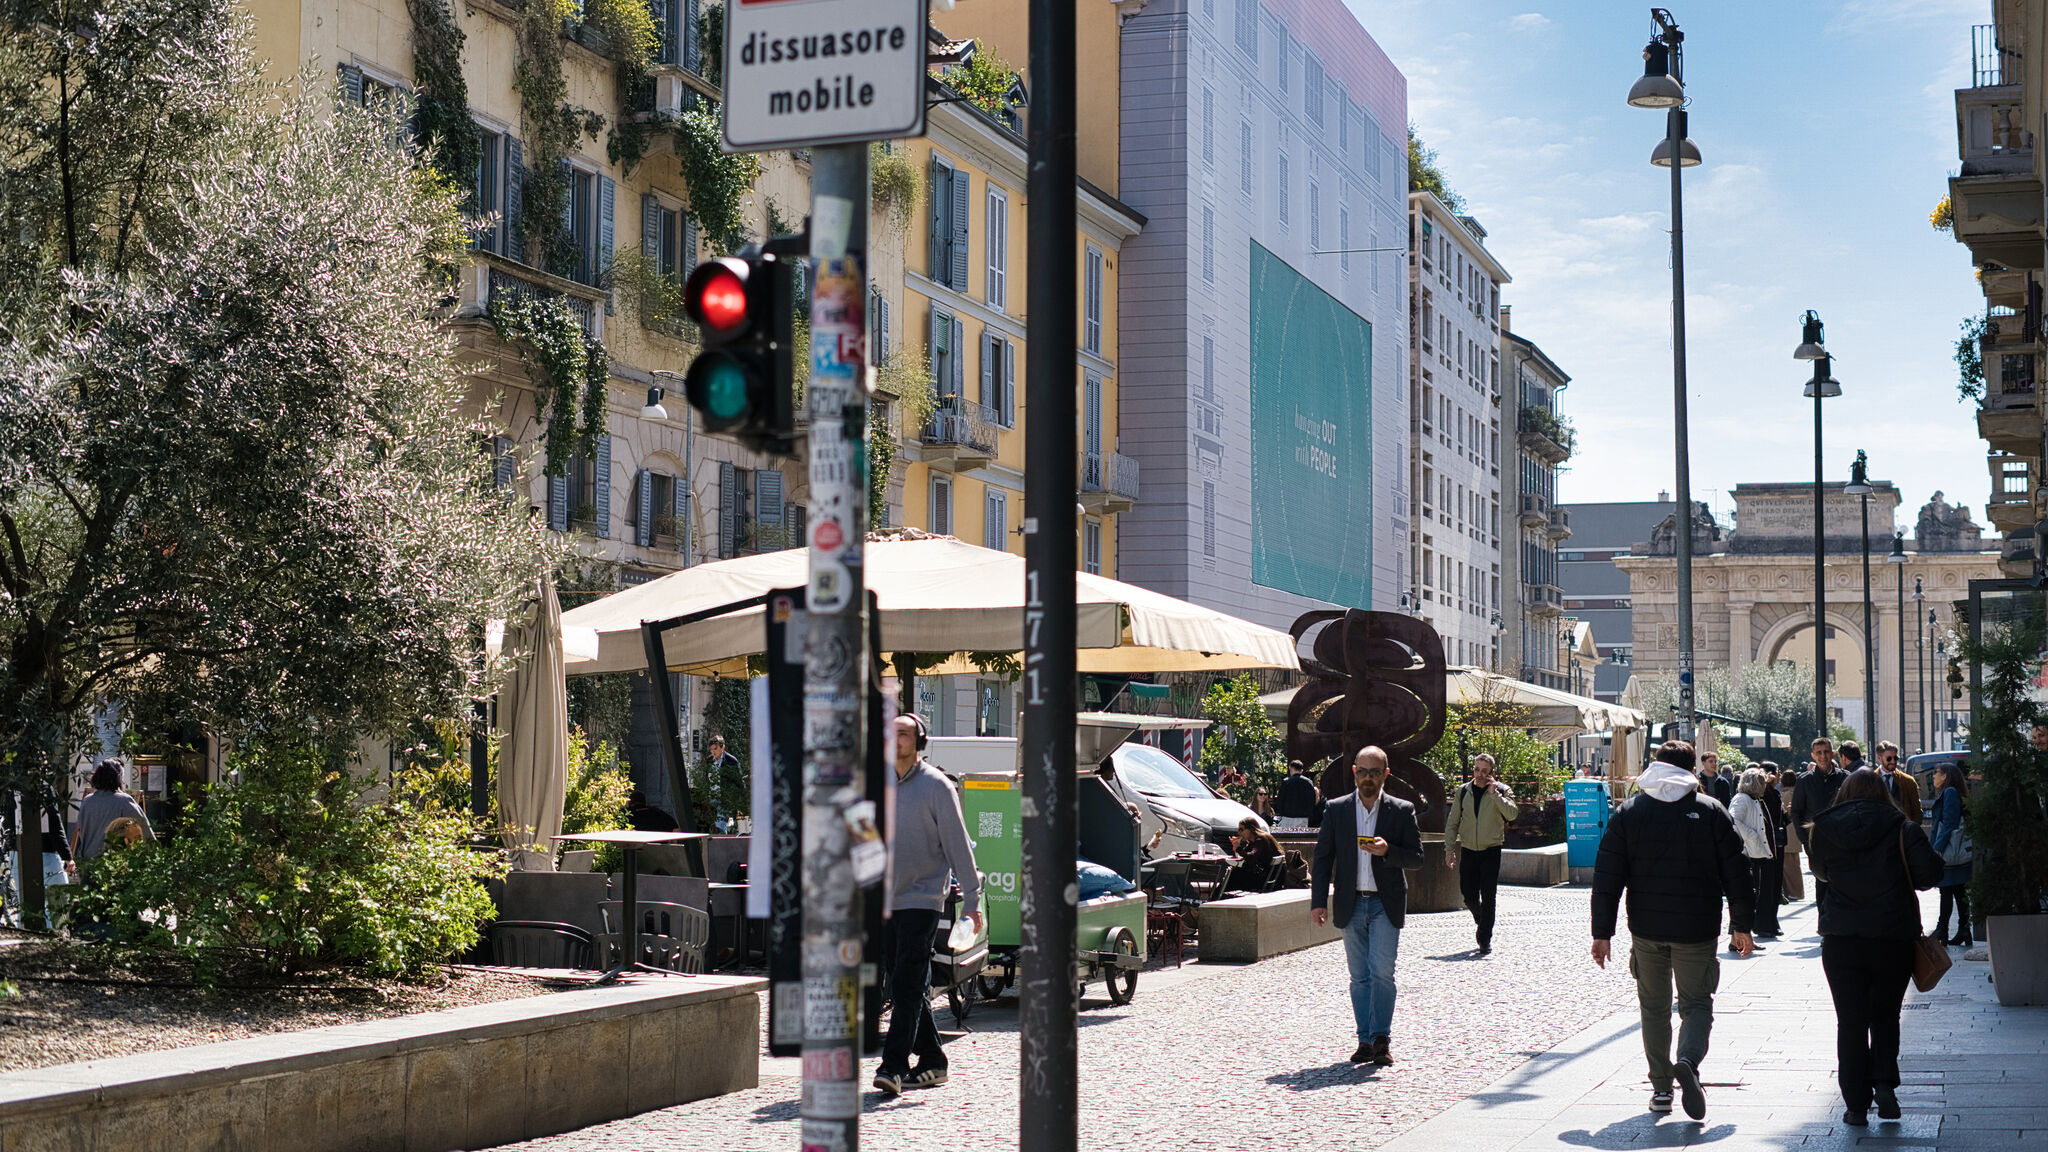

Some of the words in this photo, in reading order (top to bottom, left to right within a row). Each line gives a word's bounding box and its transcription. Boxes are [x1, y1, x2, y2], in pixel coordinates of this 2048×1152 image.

[740, 25, 906, 67] dissuasore
[769, 75, 875, 116] mobile
[1321, 418, 1337, 447] OUT
[1310, 444, 1337, 479] PEOPLE
[987, 893, 1021, 904] hospitality
